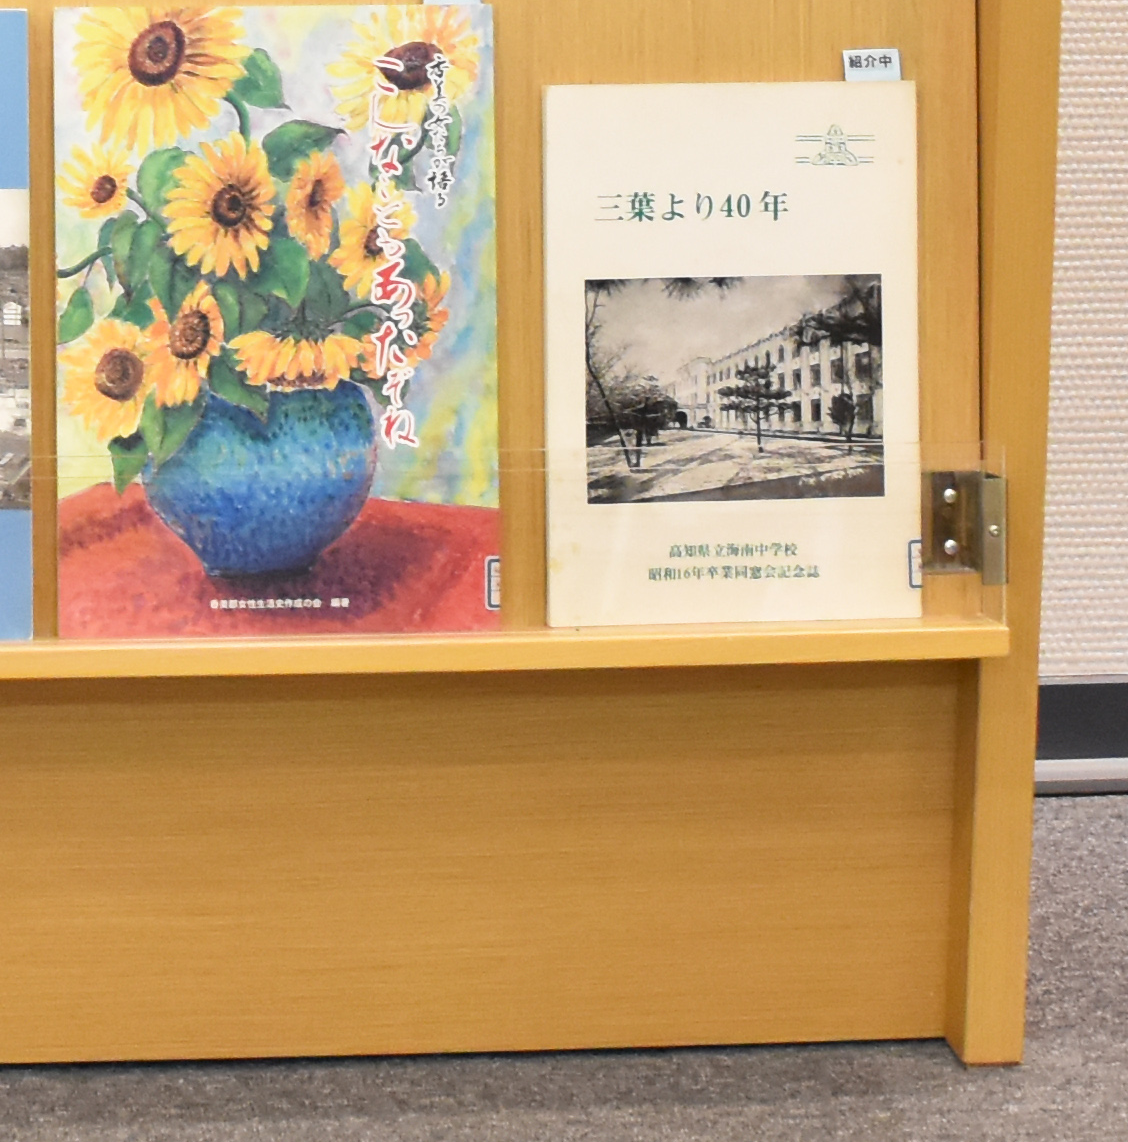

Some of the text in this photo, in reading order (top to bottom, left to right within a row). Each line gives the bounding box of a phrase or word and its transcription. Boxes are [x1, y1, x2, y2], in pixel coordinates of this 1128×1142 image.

[848, 54, 893, 69] 紹介中
[595, 191, 789, 223] 三葉より40年
[668, 543, 799, 559] 高知県立海南中学校
[647, 564, 820, 581] 昭和16年卒業同窓会記念誌
